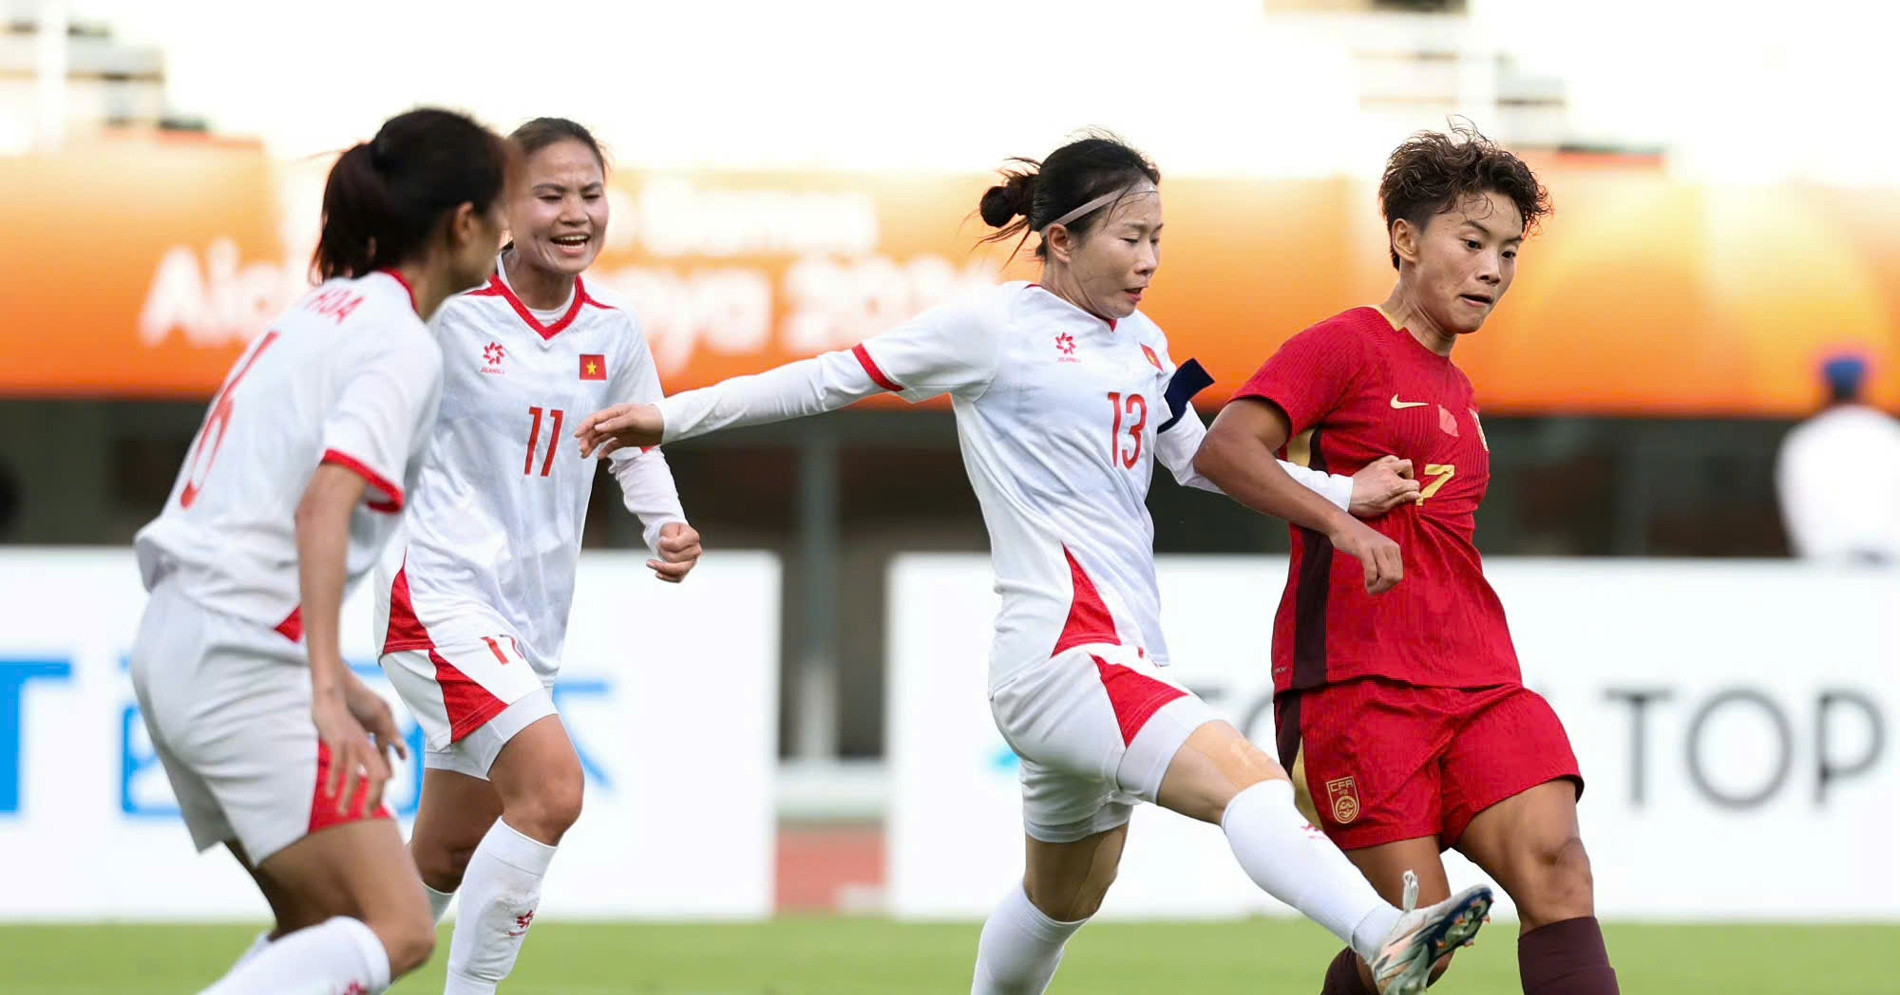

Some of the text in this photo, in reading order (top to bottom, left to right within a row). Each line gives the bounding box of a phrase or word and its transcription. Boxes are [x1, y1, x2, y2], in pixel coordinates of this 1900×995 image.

[179, 330, 281, 509] 6
[524, 406, 564, 477] 11
[1107, 391, 1147, 470] 13
[1415, 464, 1455, 506] 7
[1600, 684, 1886, 810] TOP
[1330, 779, 1353, 793] CFA
